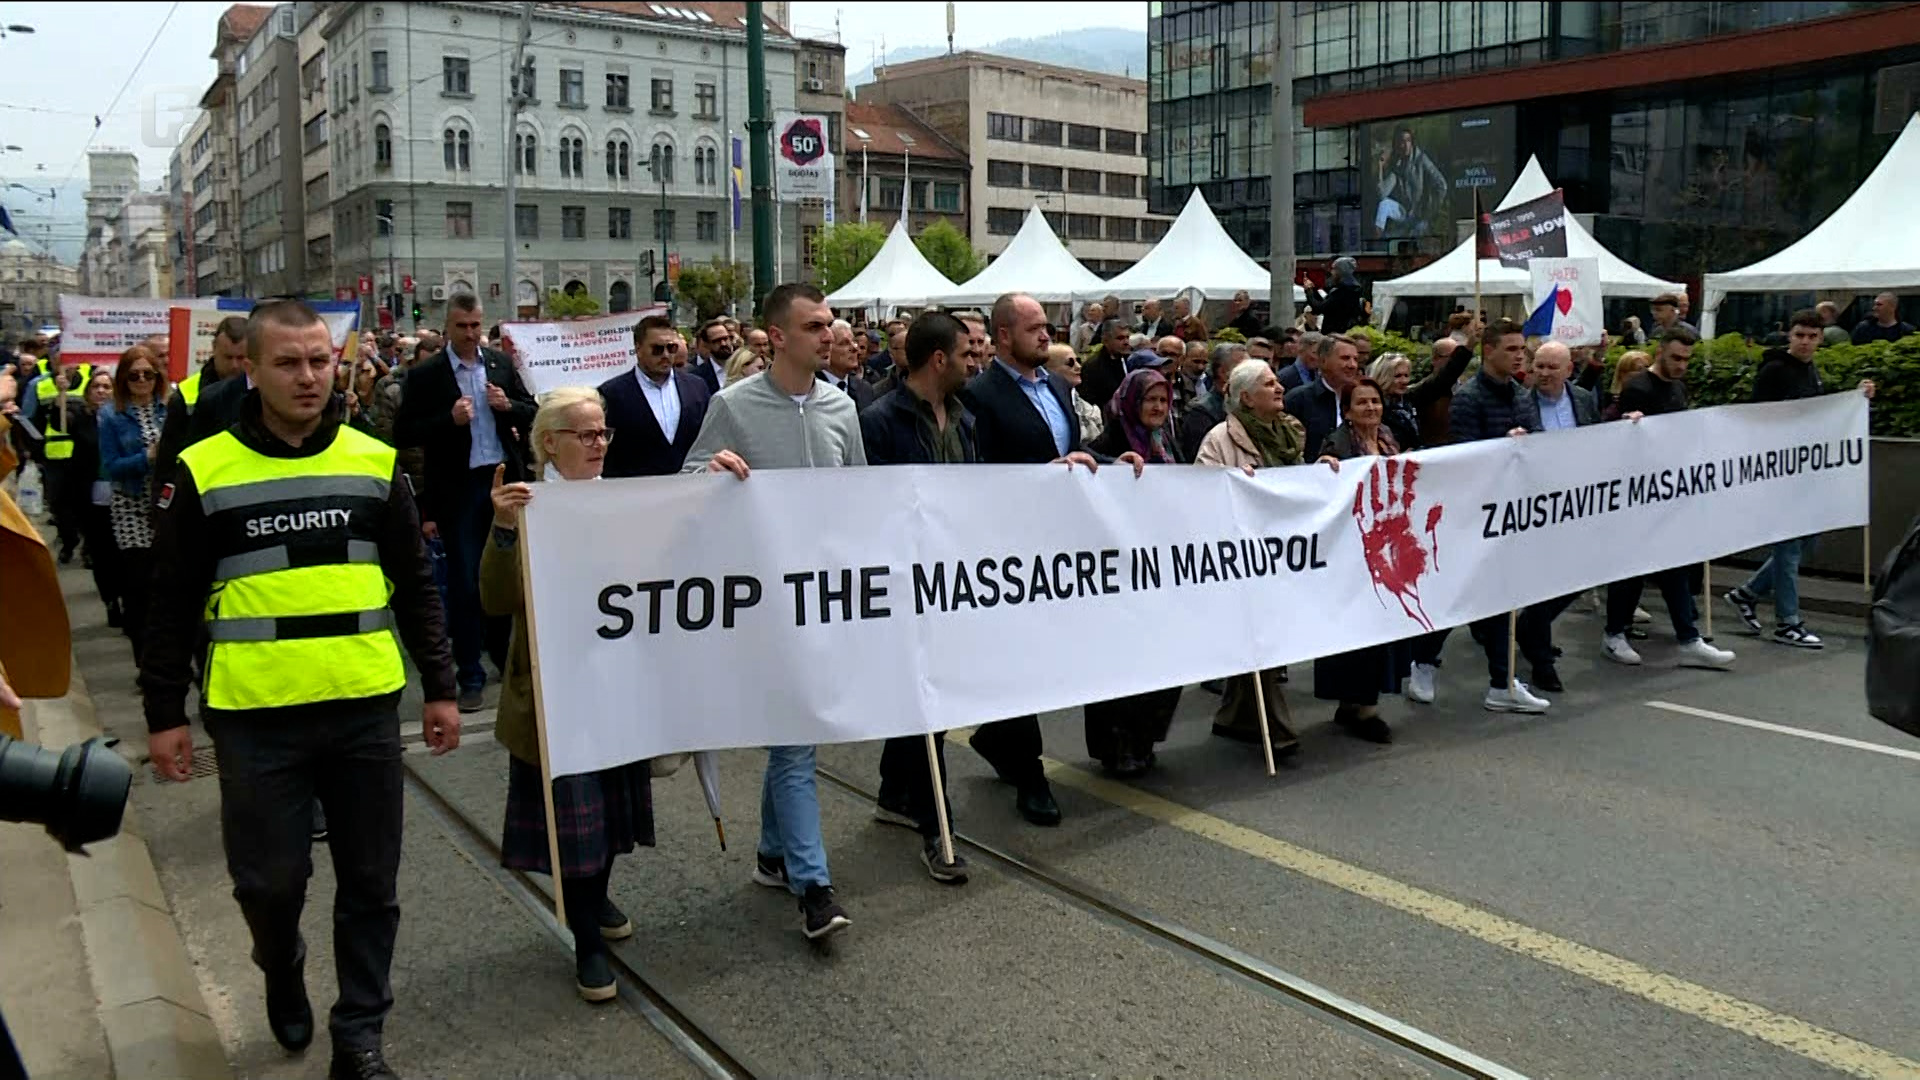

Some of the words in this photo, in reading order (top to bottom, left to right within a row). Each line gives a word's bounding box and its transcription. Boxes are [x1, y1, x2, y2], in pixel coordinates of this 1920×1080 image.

[1532, 216, 1566, 236] NOW
[535, 335, 558, 344] STOP
[561, 330, 596, 341] KILLING
[528, 356, 582, 369] ZAUSTAVITE
[1481, 478, 1623, 539] ZAUSTAVITE
[1627, 462, 1718, 508] MASAKR
[1722, 459, 1734, 488] U
[1739, 437, 1865, 484] MARIUPOLJU
[246, 509, 352, 537] SECURITY
[596, 575, 762, 640] STOP
[783, 565, 892, 627] THE
[912, 548, 1121, 616] MASSACRE
[1131, 546, 1161, 591] IN
[1170, 533, 1328, 586] MARIUPOL
